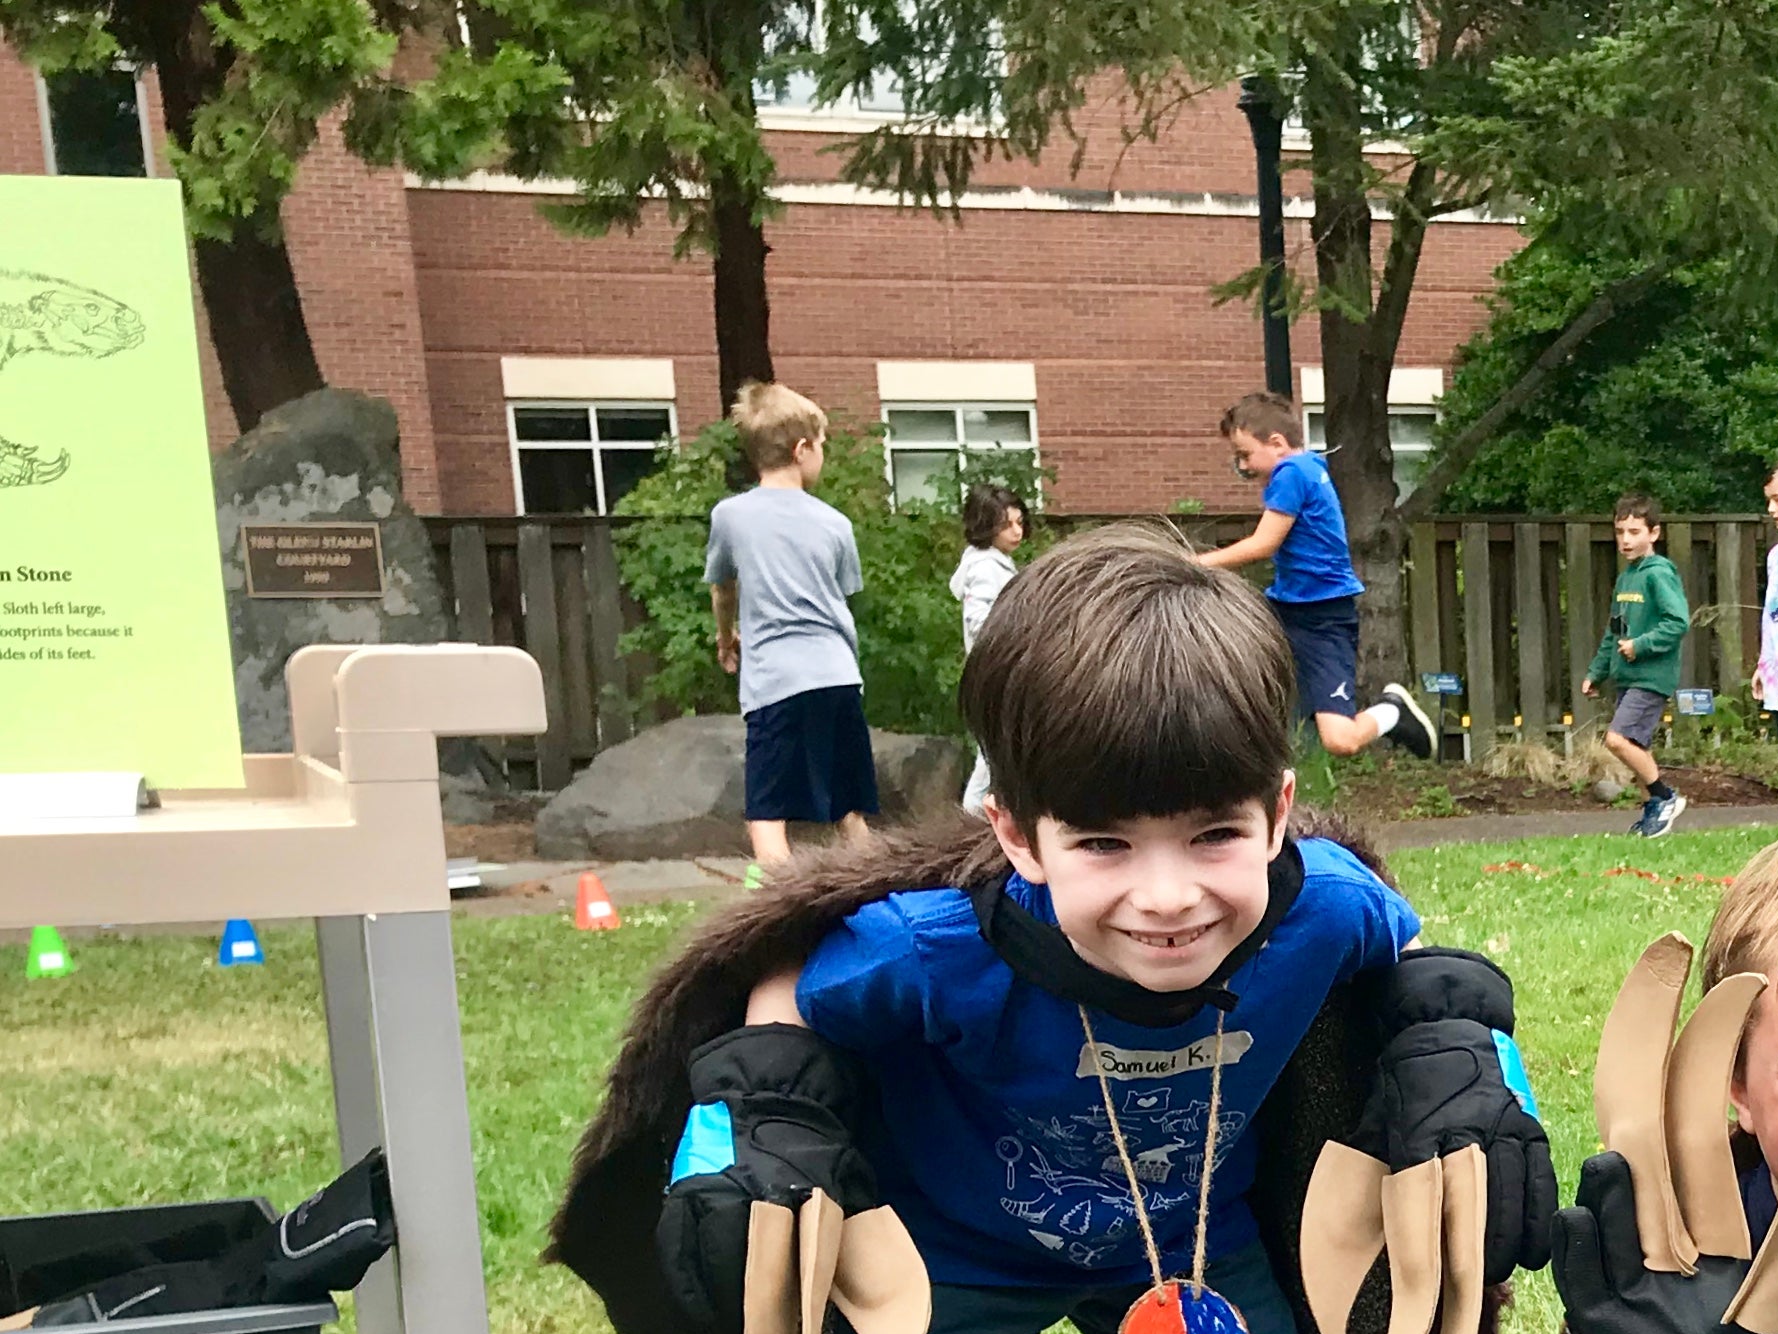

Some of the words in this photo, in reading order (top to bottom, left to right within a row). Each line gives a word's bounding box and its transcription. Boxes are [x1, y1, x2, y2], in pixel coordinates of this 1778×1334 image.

[0, 570, 11, 582] n
[17, 566, 72, 582] Stone
[3, 602, 39, 614] Sloth
[42, 602, 64, 614] left
[68, 601, 105, 617] large,
[0, 627, 63, 641] ootprints
[66, 624, 119, 637] because
[124, 626, 133, 637] it
[29, 647, 44, 660] of
[47, 647, 64, 660] its
[67, 647, 95, 659] feet.
[1101, 1050, 1177, 1074] Samuel
[1187, 1046, 1211, 1066] K.
